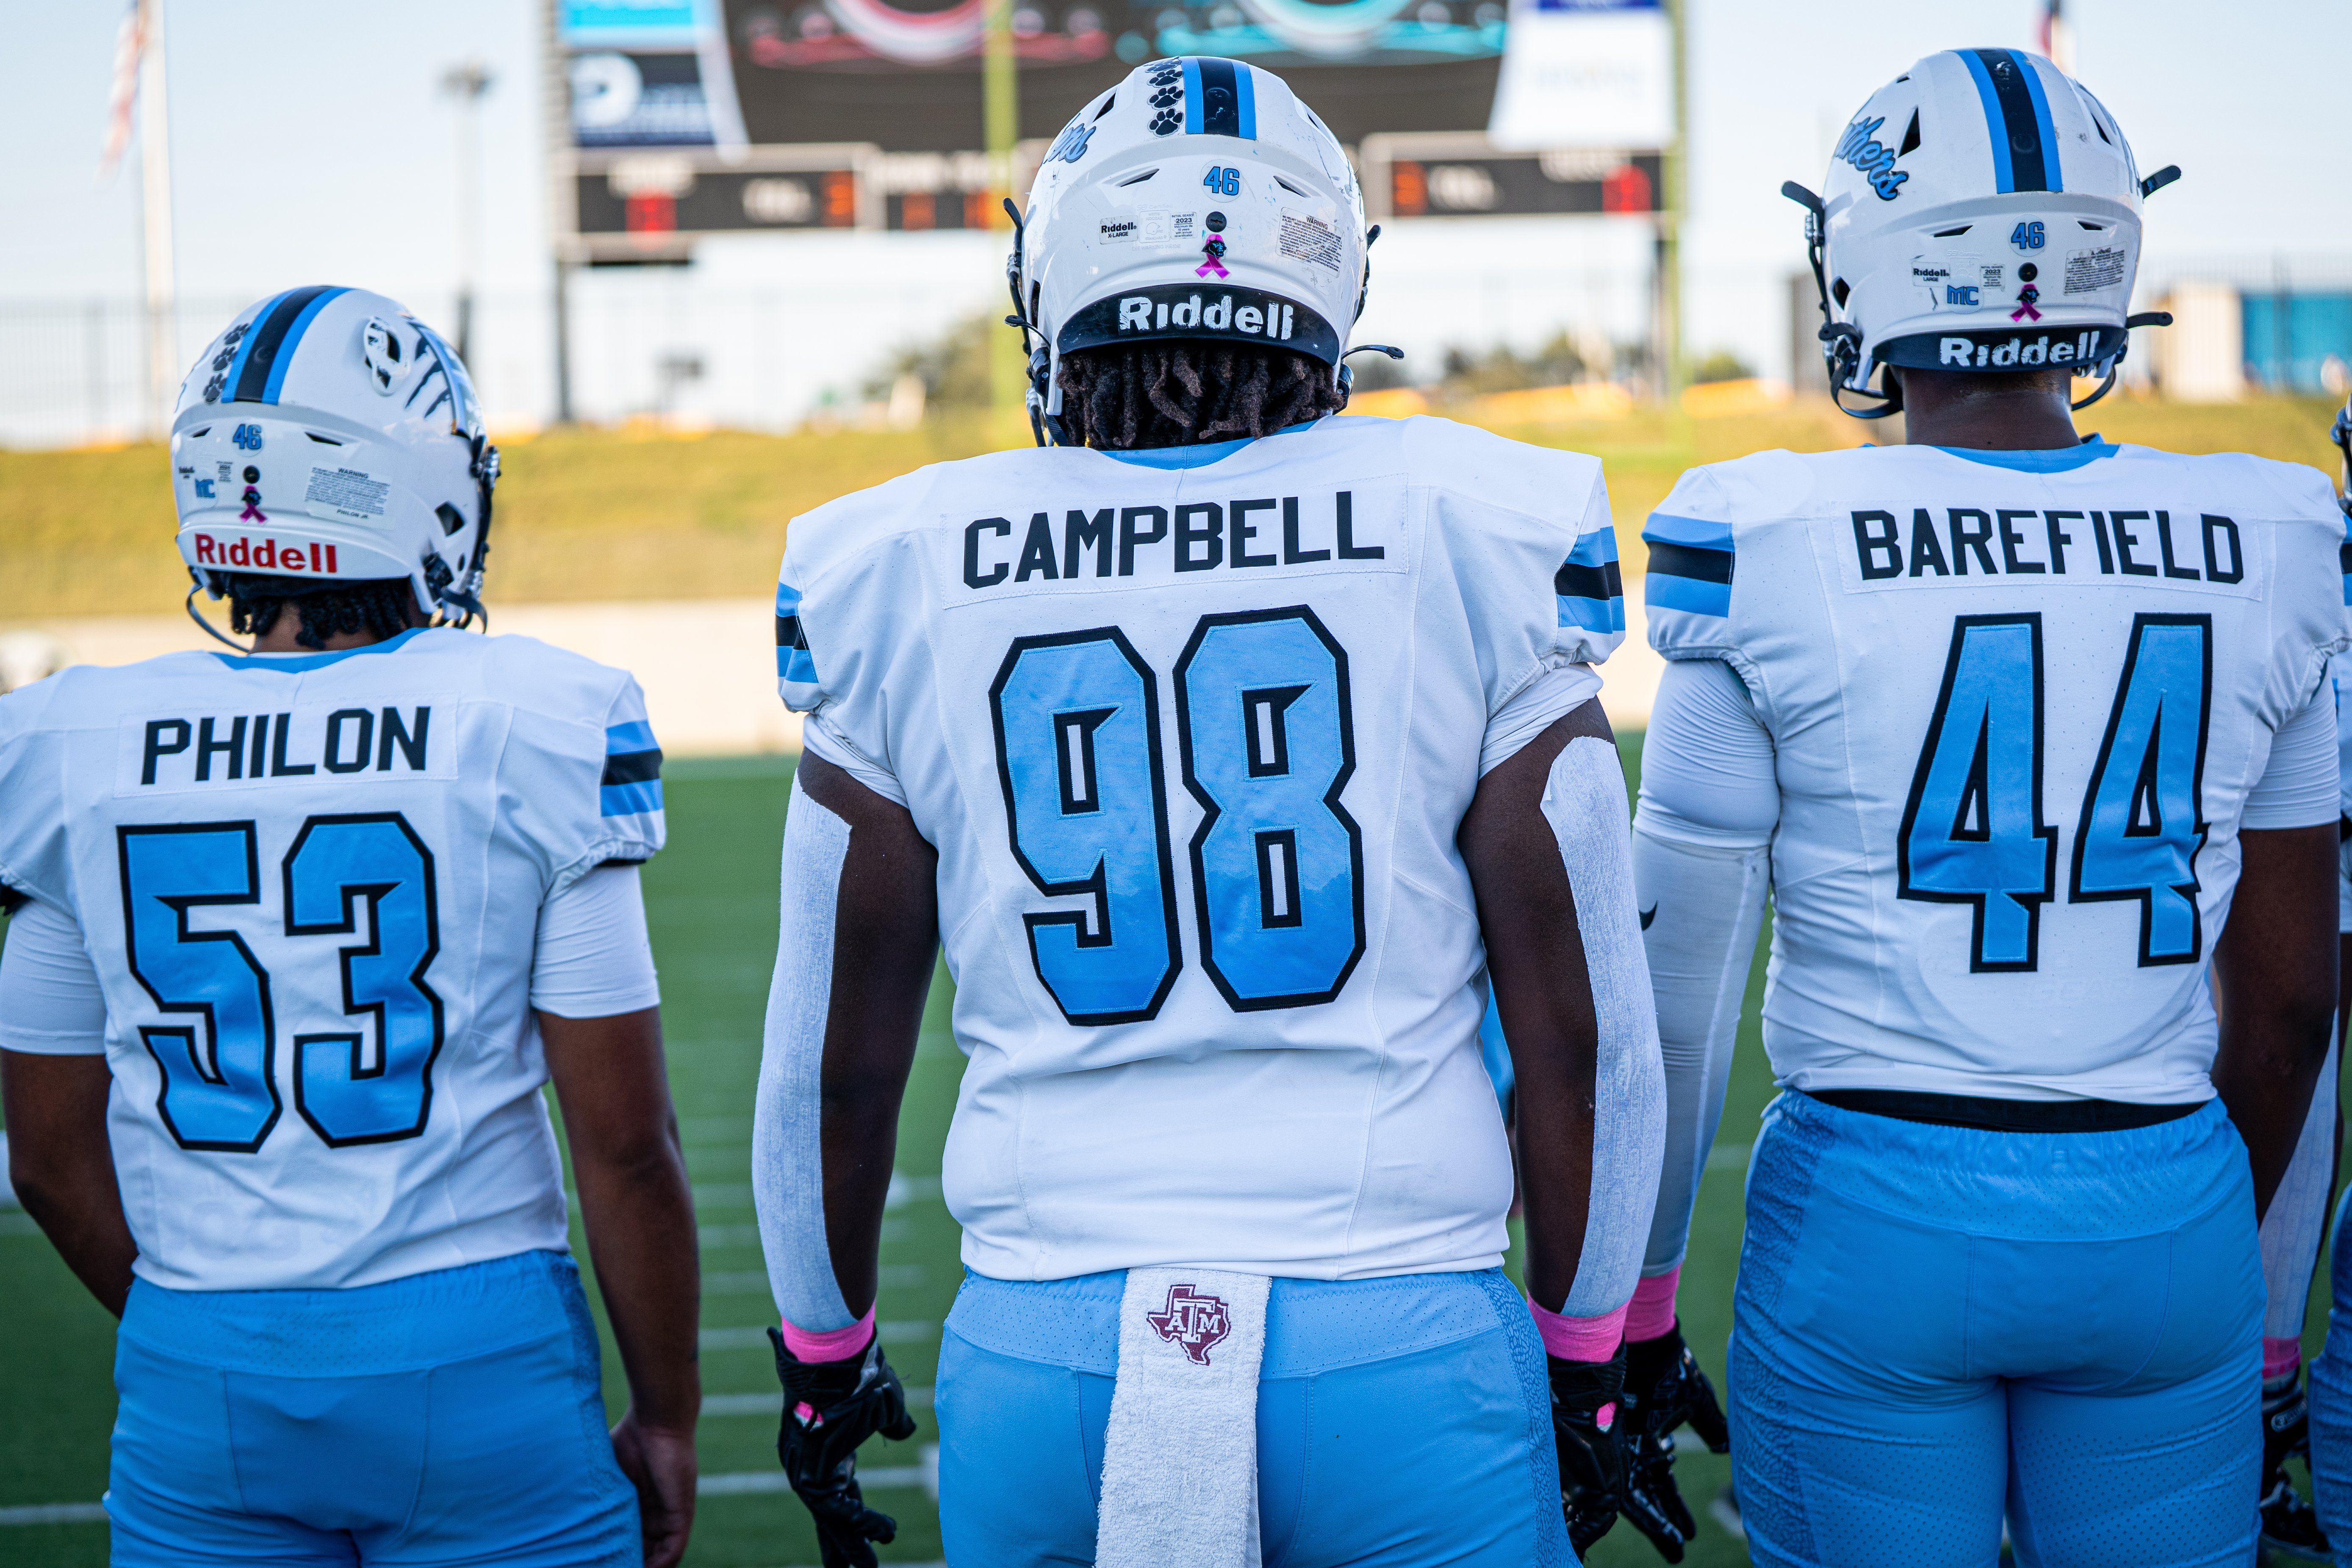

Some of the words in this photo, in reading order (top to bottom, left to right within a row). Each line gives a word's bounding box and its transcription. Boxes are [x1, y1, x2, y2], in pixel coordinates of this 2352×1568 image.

[1203, 166, 1240, 196] 46
[1306, 216, 1328, 230] WARNING
[2011, 222, 2044, 249] 46
[1947, 285, 1978, 305] MC
[1118, 294, 1293, 340] Riddell
[1939, 330, 2100, 367] Riddell
[233, 424, 262, 450] 46
[338, 467, 368, 479] WARNING
[194, 532, 337, 573] Riddell
[963, 491, 1385, 589] CAMPBELL
[1851, 508, 2244, 585] BAREFIELD
[141, 706, 431, 785] PHILON
[1896, 611, 2213, 974] 44
[988, 604, 1366, 1027] 98
[115, 811, 445, 1154] 53
